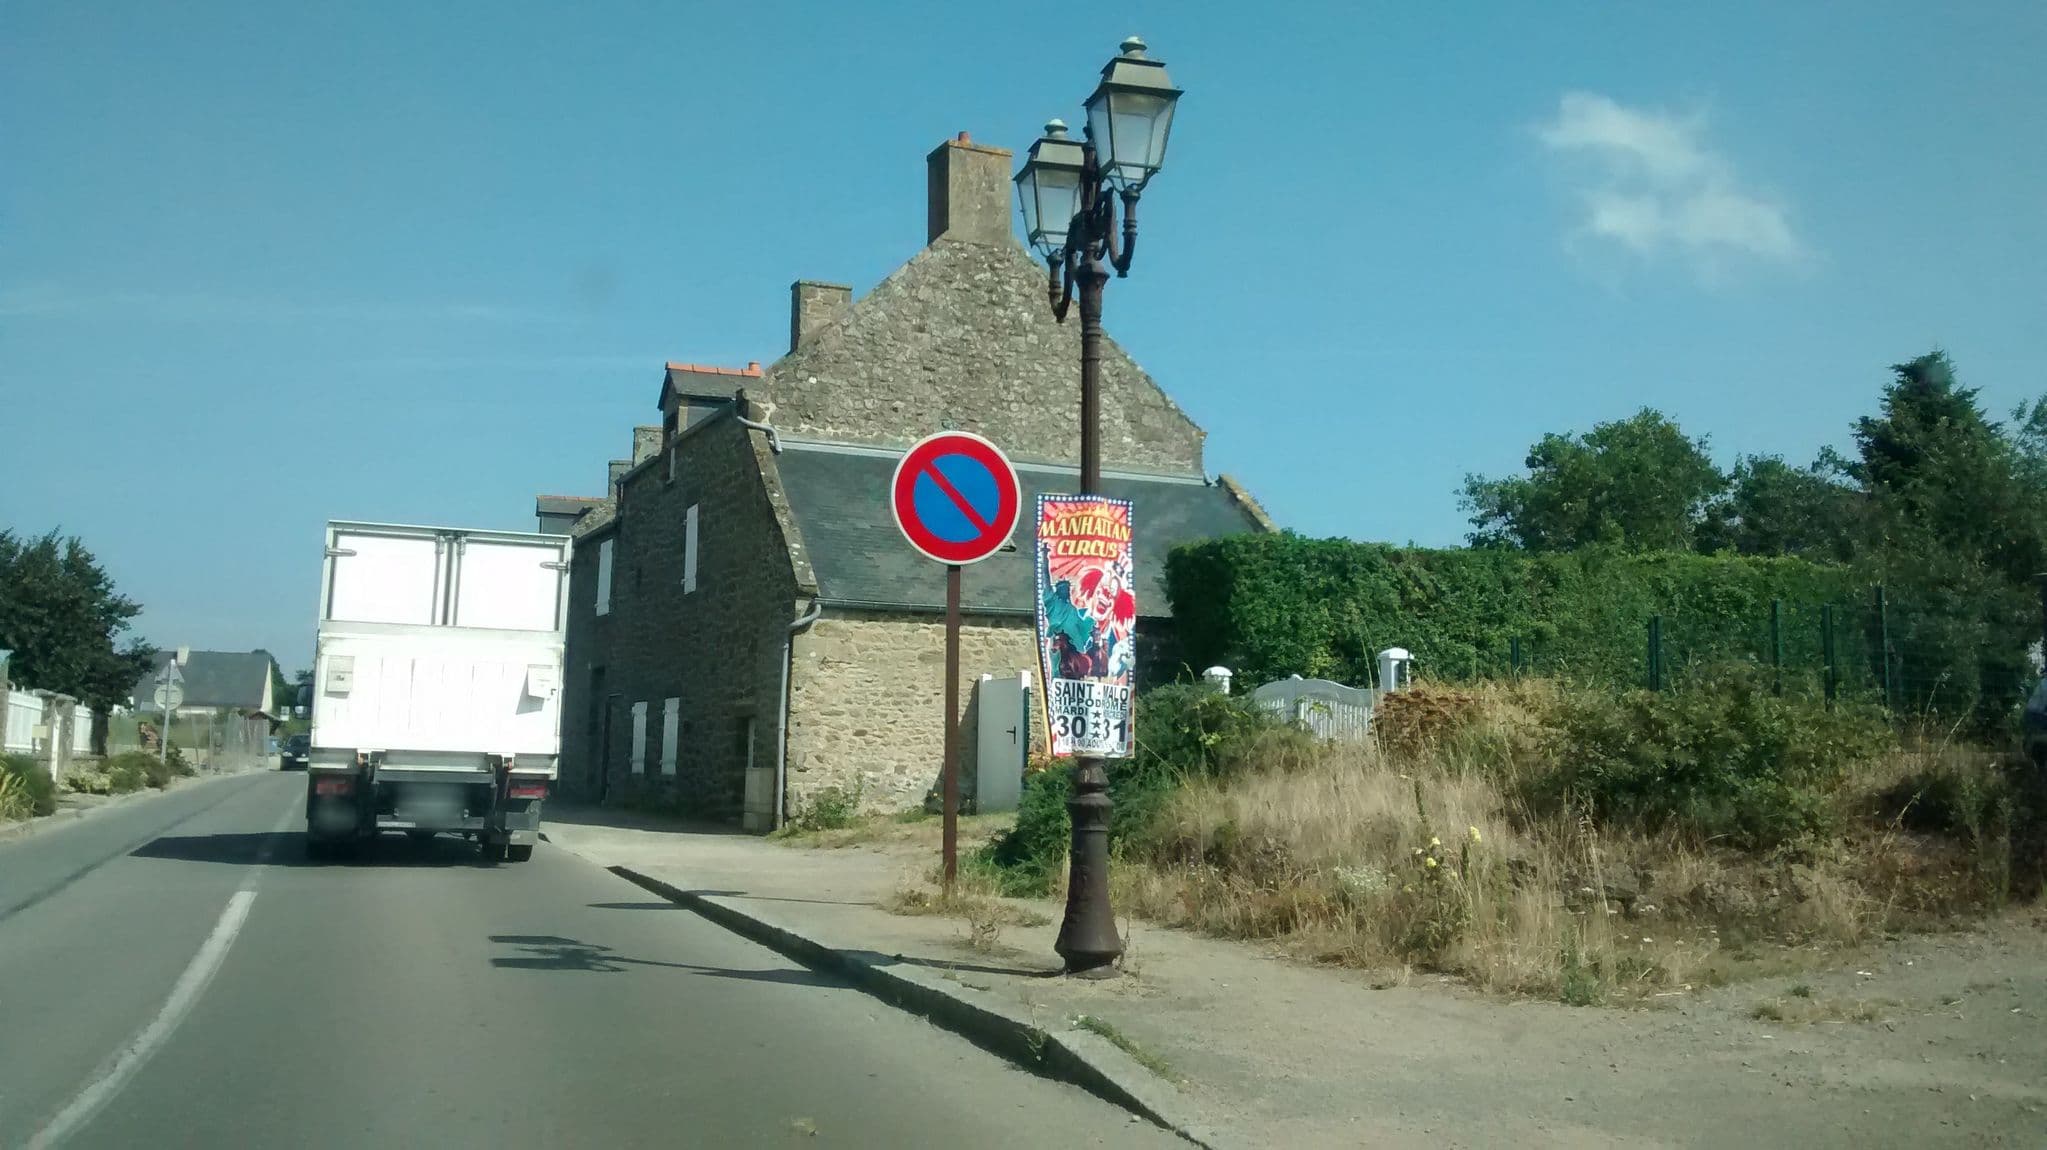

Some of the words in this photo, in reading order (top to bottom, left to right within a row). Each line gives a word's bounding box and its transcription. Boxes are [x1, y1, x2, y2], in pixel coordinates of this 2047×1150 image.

[1038, 516, 1131, 542] MANHATTAN
[1057, 539, 1118, 558] CIRCUS
[1054, 681, 1095, 699] SAINT
[1054, 697, 1127, 711] HIPPODROME
[1055, 705, 1088, 716] MARDI
[1056, 715, 1087, 739] 30
